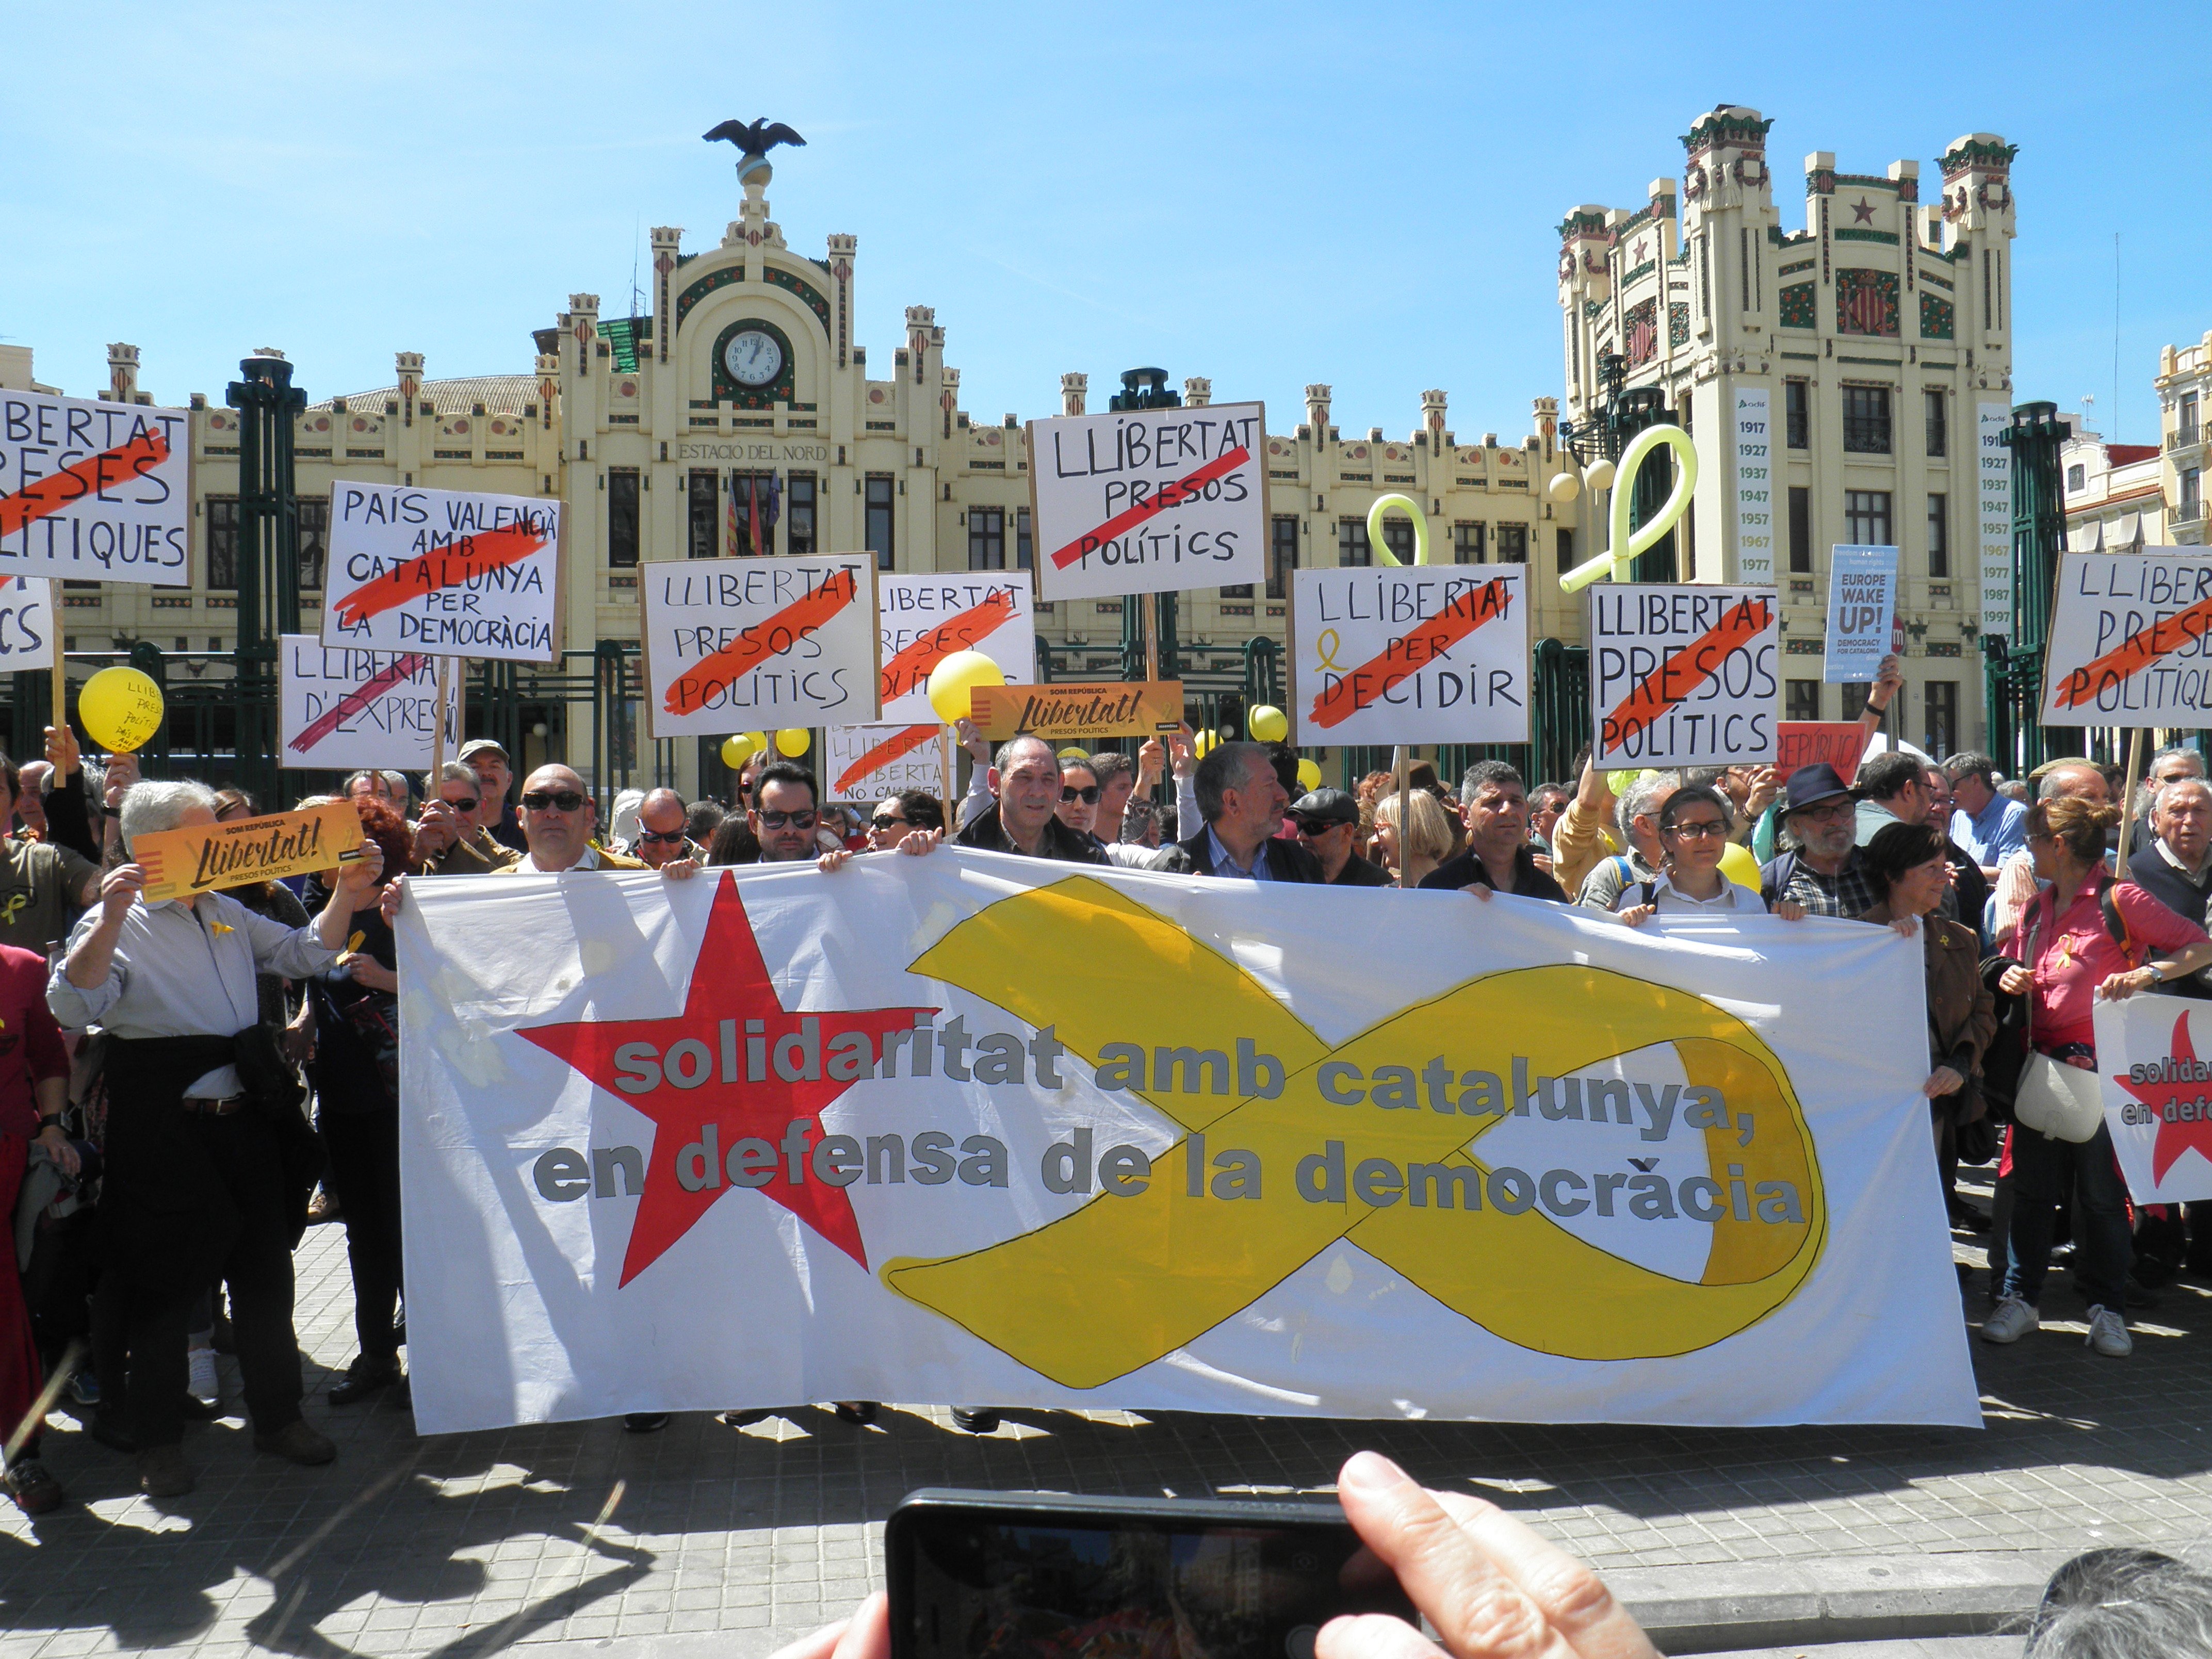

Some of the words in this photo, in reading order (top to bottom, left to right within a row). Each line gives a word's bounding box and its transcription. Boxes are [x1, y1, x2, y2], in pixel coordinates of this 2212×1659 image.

[1740, 421, 1765, 434] 1917
[679, 441, 743, 460] ESTACIÓ
[748, 445, 780, 460] DEL
[783, 446, 826, 461] NORD
[1054, 418, 1259, 478] LLIBERTAT
[1739, 444, 1767, 457] 1927
[1982, 435, 1998, 447] 191
[1740, 467, 1768, 480] 1937
[1981, 458, 2007, 469] 1927
[1105, 474, 1248, 518] PRESOS
[1740, 490, 1769, 502] 1947
[1982, 479, 2008, 491] 1937
[345, 487, 429, 525] PAÍS
[1982, 501, 2008, 513] 1947
[1741, 513, 1769, 525] 1957
[1983, 523, 2008, 535] 1957
[412, 529, 476, 557] AMB
[1081, 524, 1239, 571] POLÍTICS
[1741, 535, 1770, 548] 1967
[1983, 545, 2009, 557] 1967
[347, 553, 544, 594] CATALUNYA
[1742, 559, 1769, 571] 1977
[1983, 566, 2009, 579] 1977
[665, 564, 862, 607] LLIBERTAT
[1842, 574, 1886, 586] EUROPE
[427, 593, 481, 615] PER
[1319, 575, 1519, 623] LLIBERTAT
[1841, 588, 1885, 604] WAKE
[1983, 589, 2010, 600] 1987
[1599, 594, 1777, 636] LLIBERTAT
[1839, 606, 1883, 635] UP!
[1984, 611, 2010, 622] 1997
[337, 611, 372, 638] LA
[400, 611, 552, 652] DEMOCRÀCIA
[674, 626, 822, 658] PRESOS
[881, 628, 975, 656] RESES
[1387, 635, 1452, 661] PER
[1837, 639, 1881, 647] DEMOCRACY
[1324, 663, 1522, 710] DECIDIR
[1599, 644, 1777, 708] PRESOS
[679, 666, 849, 710] POLÍTICS
[1014, 690, 1143, 736] Llibertat!
[1599, 705, 1768, 761] POLÍTICS
[844, 786, 867, 800] NO
[225, 826, 244, 835] SOM
[245, 819, 286, 832] REPÚBLICA
[190, 817, 322, 889] Llibertat!
[230, 870, 258, 882] PRESOS
[260, 865, 292, 876] POLÍTICS
[612, 1013, 1063, 1094] solidaritat
[1095, 1037, 1286, 1100] amb
[1316, 1055, 1754, 1147] catalunya,
[2121, 1103, 2153, 1125] en
[533, 1143, 644, 1202] en
[676, 1118, 1009, 1193] defensa
[1041, 1127, 1151, 1197] de
[1187, 1132, 1262, 1200] la
